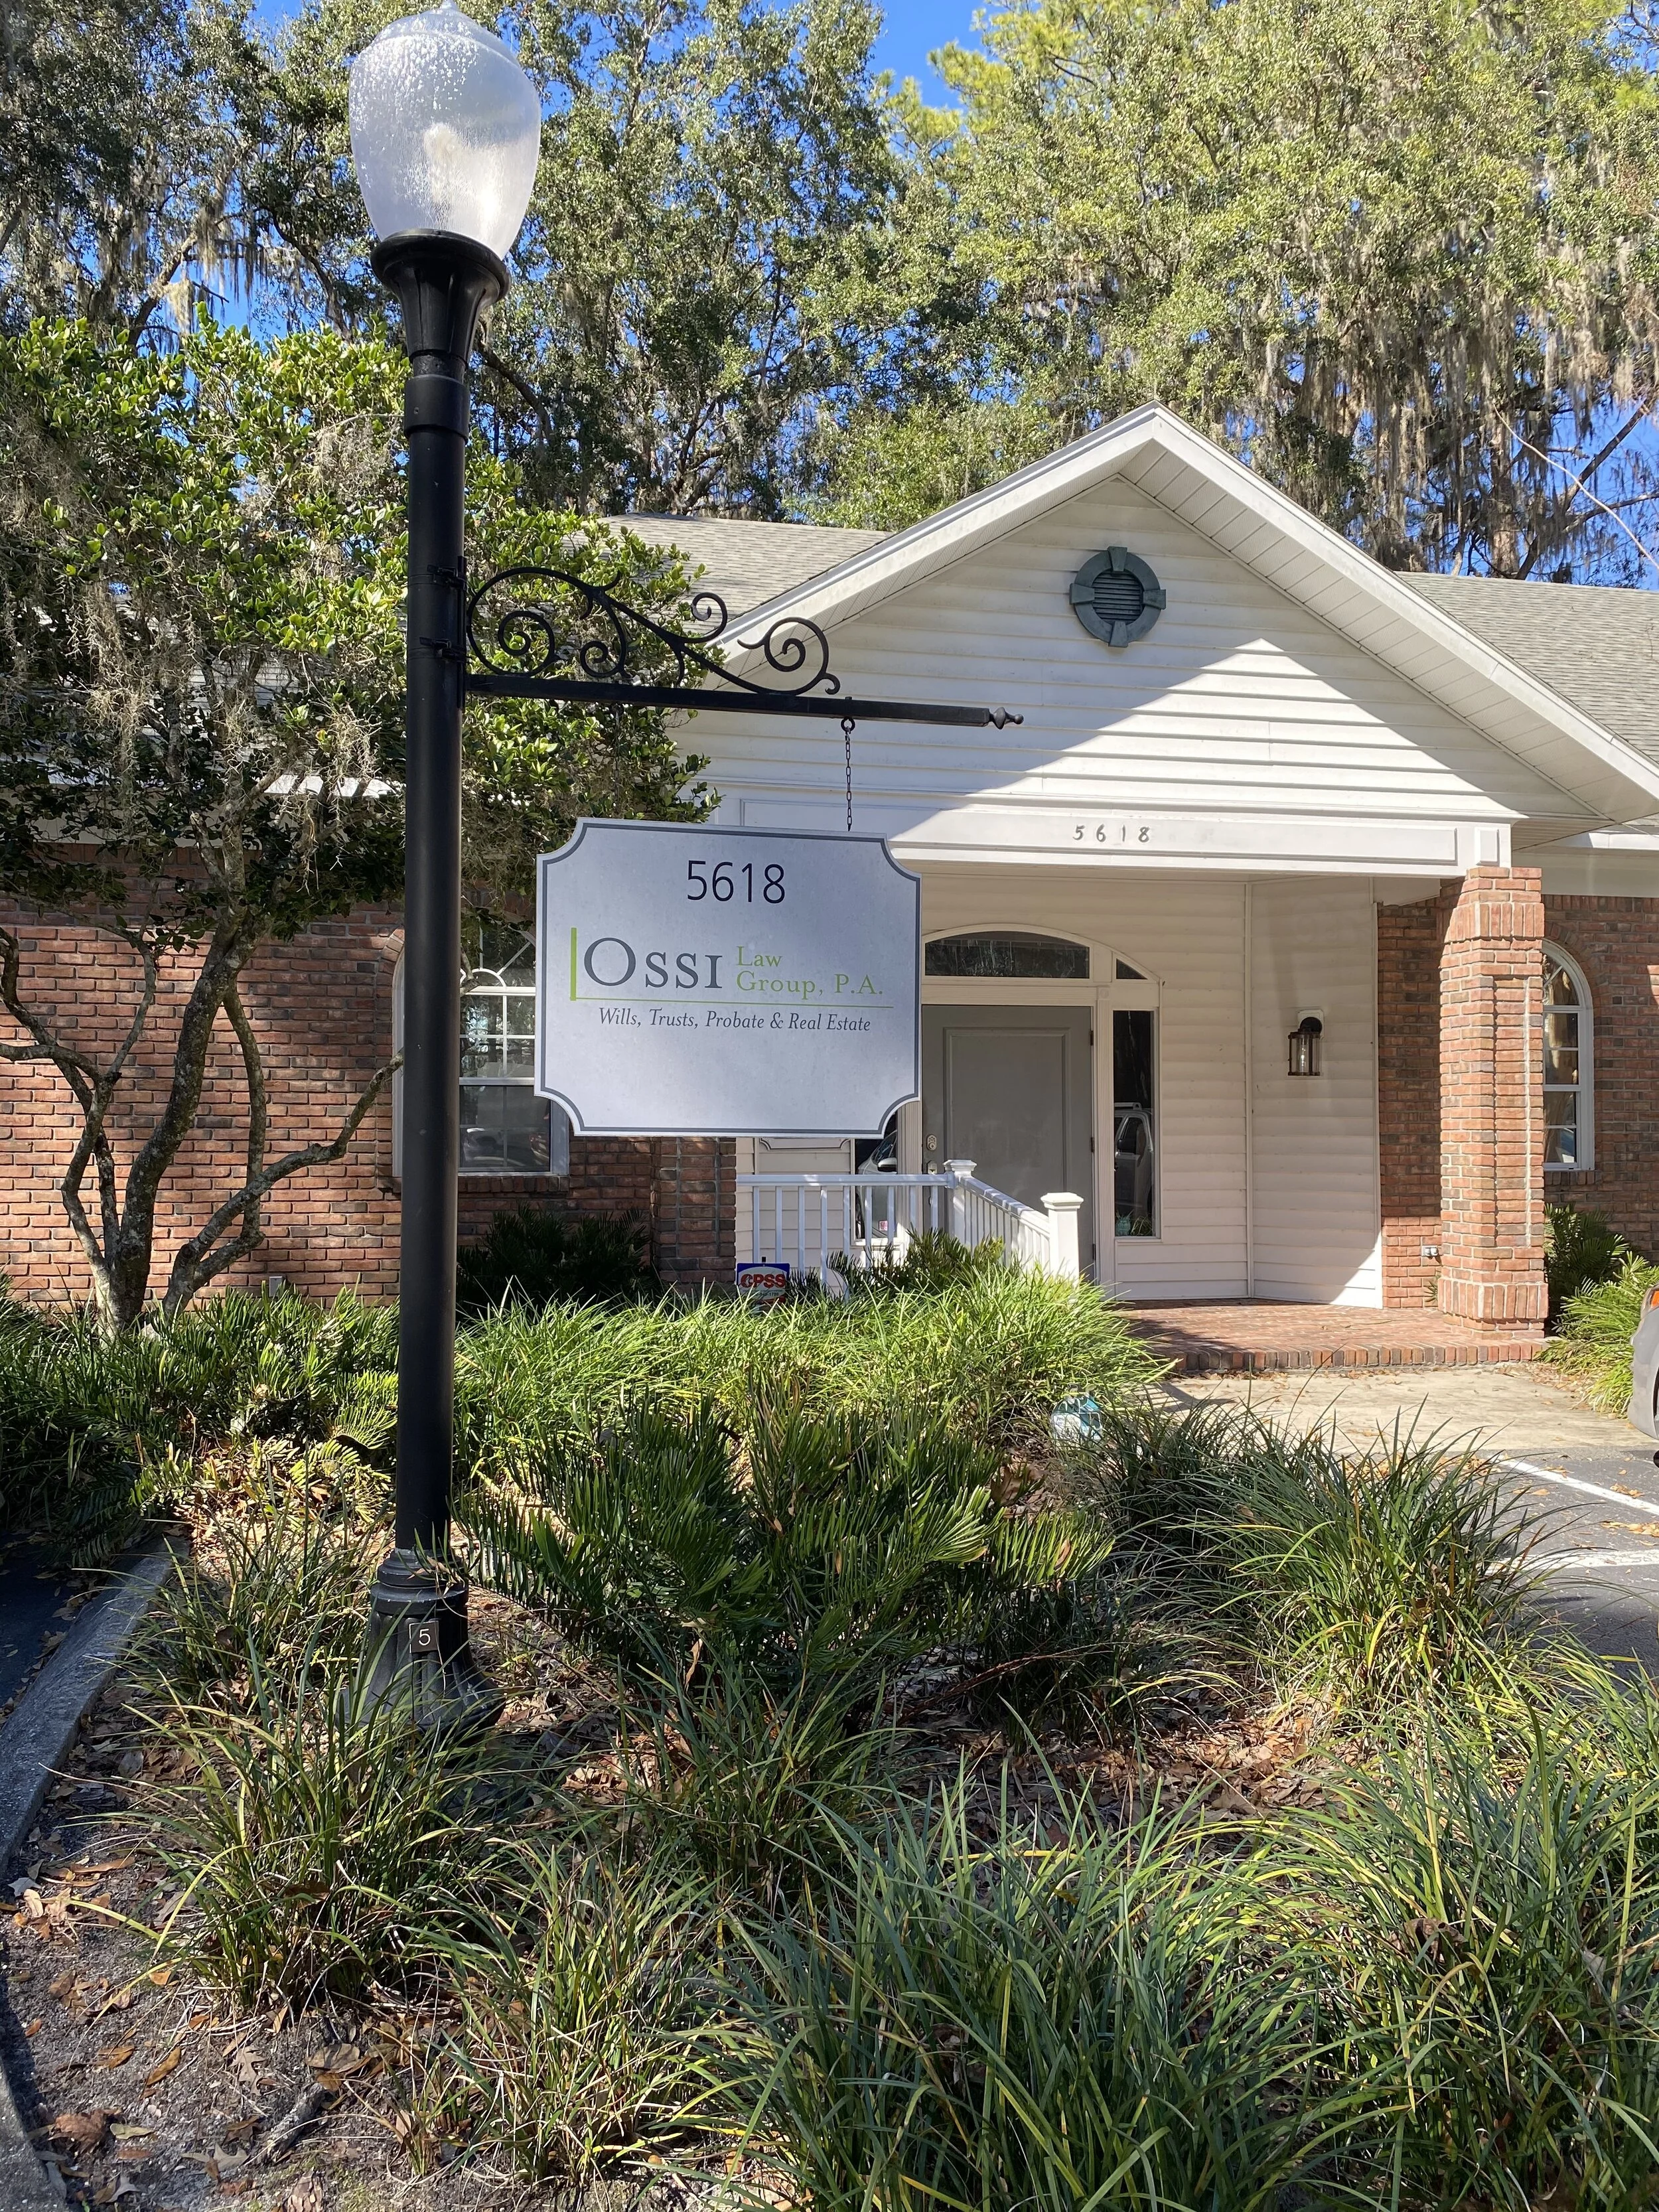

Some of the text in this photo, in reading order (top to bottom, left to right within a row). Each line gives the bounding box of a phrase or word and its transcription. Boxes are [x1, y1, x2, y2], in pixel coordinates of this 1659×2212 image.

[1072, 824, 1150, 843] 5618
[687, 860, 785, 904] 5618
[737, 946, 782, 967] Law
[737, 970, 883, 999] Group, P.A.
[599, 1007, 871, 1031] Wills, Trusts, Probate & Real Estate
[741, 1274, 786, 1288] CPSS
[418, 1628, 431, 1646] 5
